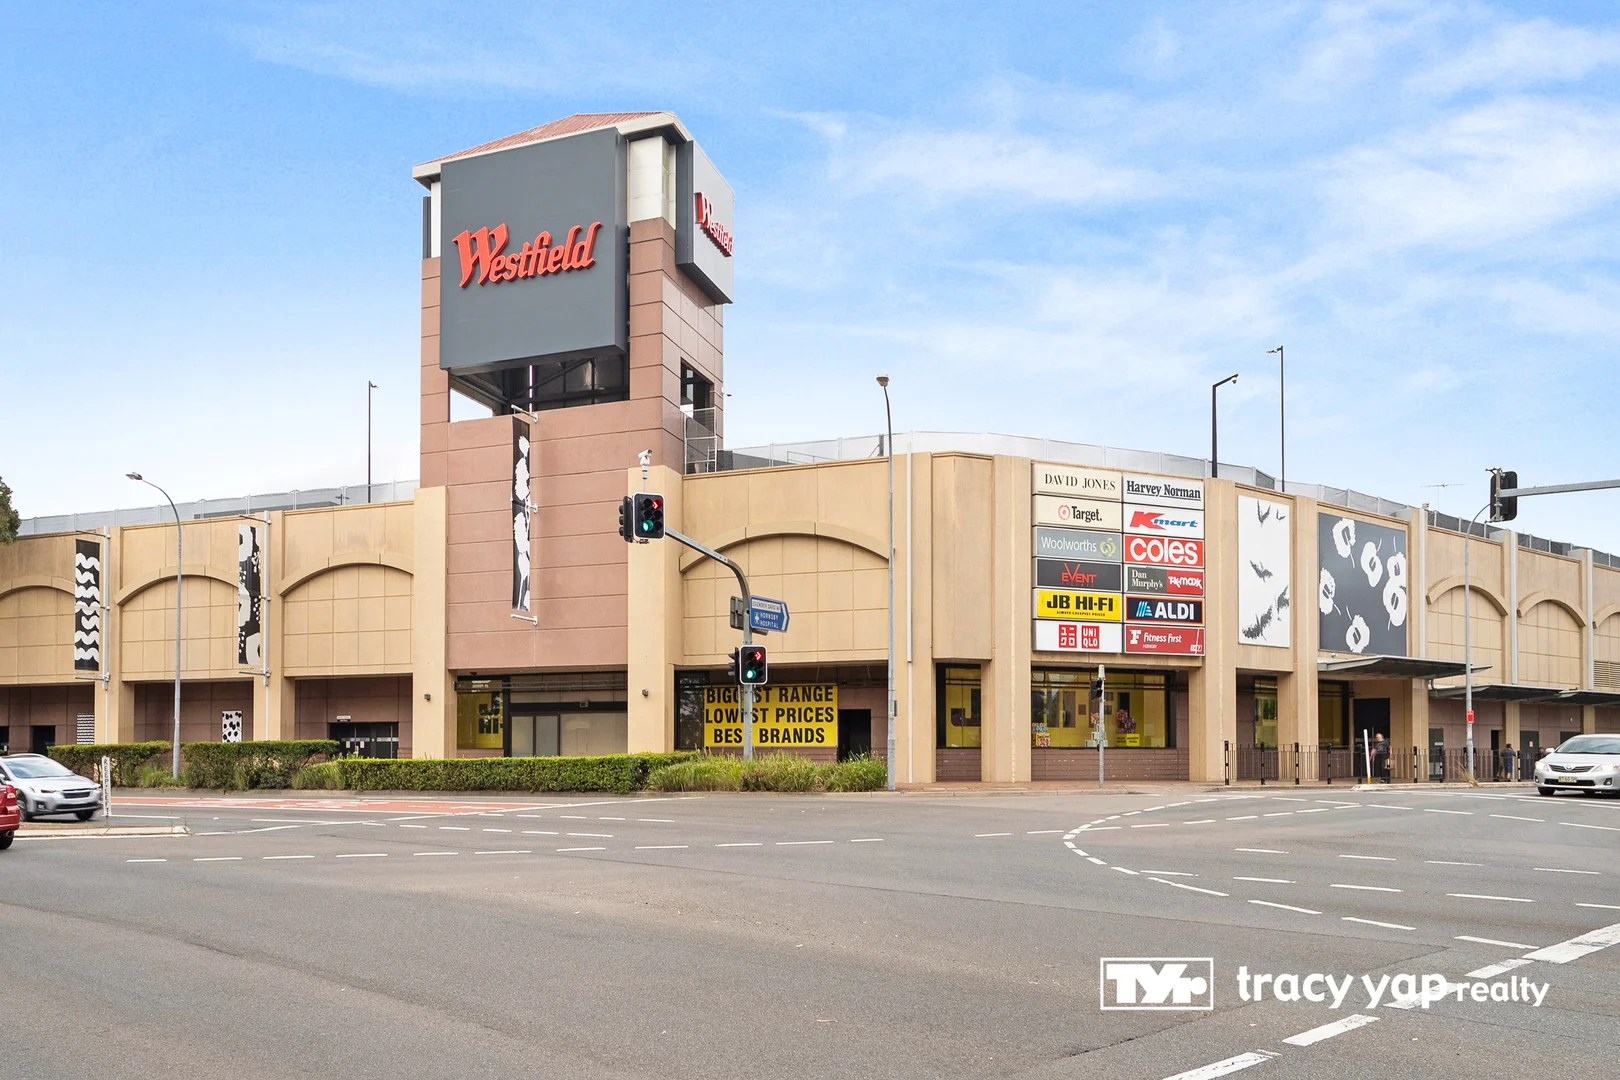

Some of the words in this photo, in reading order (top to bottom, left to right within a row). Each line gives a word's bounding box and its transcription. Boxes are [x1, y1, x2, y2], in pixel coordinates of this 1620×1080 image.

[452, 221, 603, 289] Westfield
[1045, 473, 1078, 487] DAVID
[1082, 477, 1116, 491] JONES
[1126, 480, 1162, 497] Harvey
[1163, 484, 1201, 499] Norman
[1129, 510, 1198, 531] Kmart
[1040, 536, 1098, 553] Woolworths
[1129, 537, 1199, 566] coles
[1131, 569, 1147, 579] Dan
[1131, 578, 1164, 590] Murphy's
[1046, 594, 1071, 609] JB
[1075, 596, 1114, 612] HI-FI
[1154, 601, 1195, 620] ALDI
[760, 612, 779, 621] HORNSBY
[760, 620, 779, 628] HOSPITAL
[1143, 632, 1167, 643] Fitness
[1167, 633, 1183, 644] First
[778, 686, 834, 703] RANGE
[775, 707, 835, 723] PRICES
[759, 727, 825, 744] BRANDS
